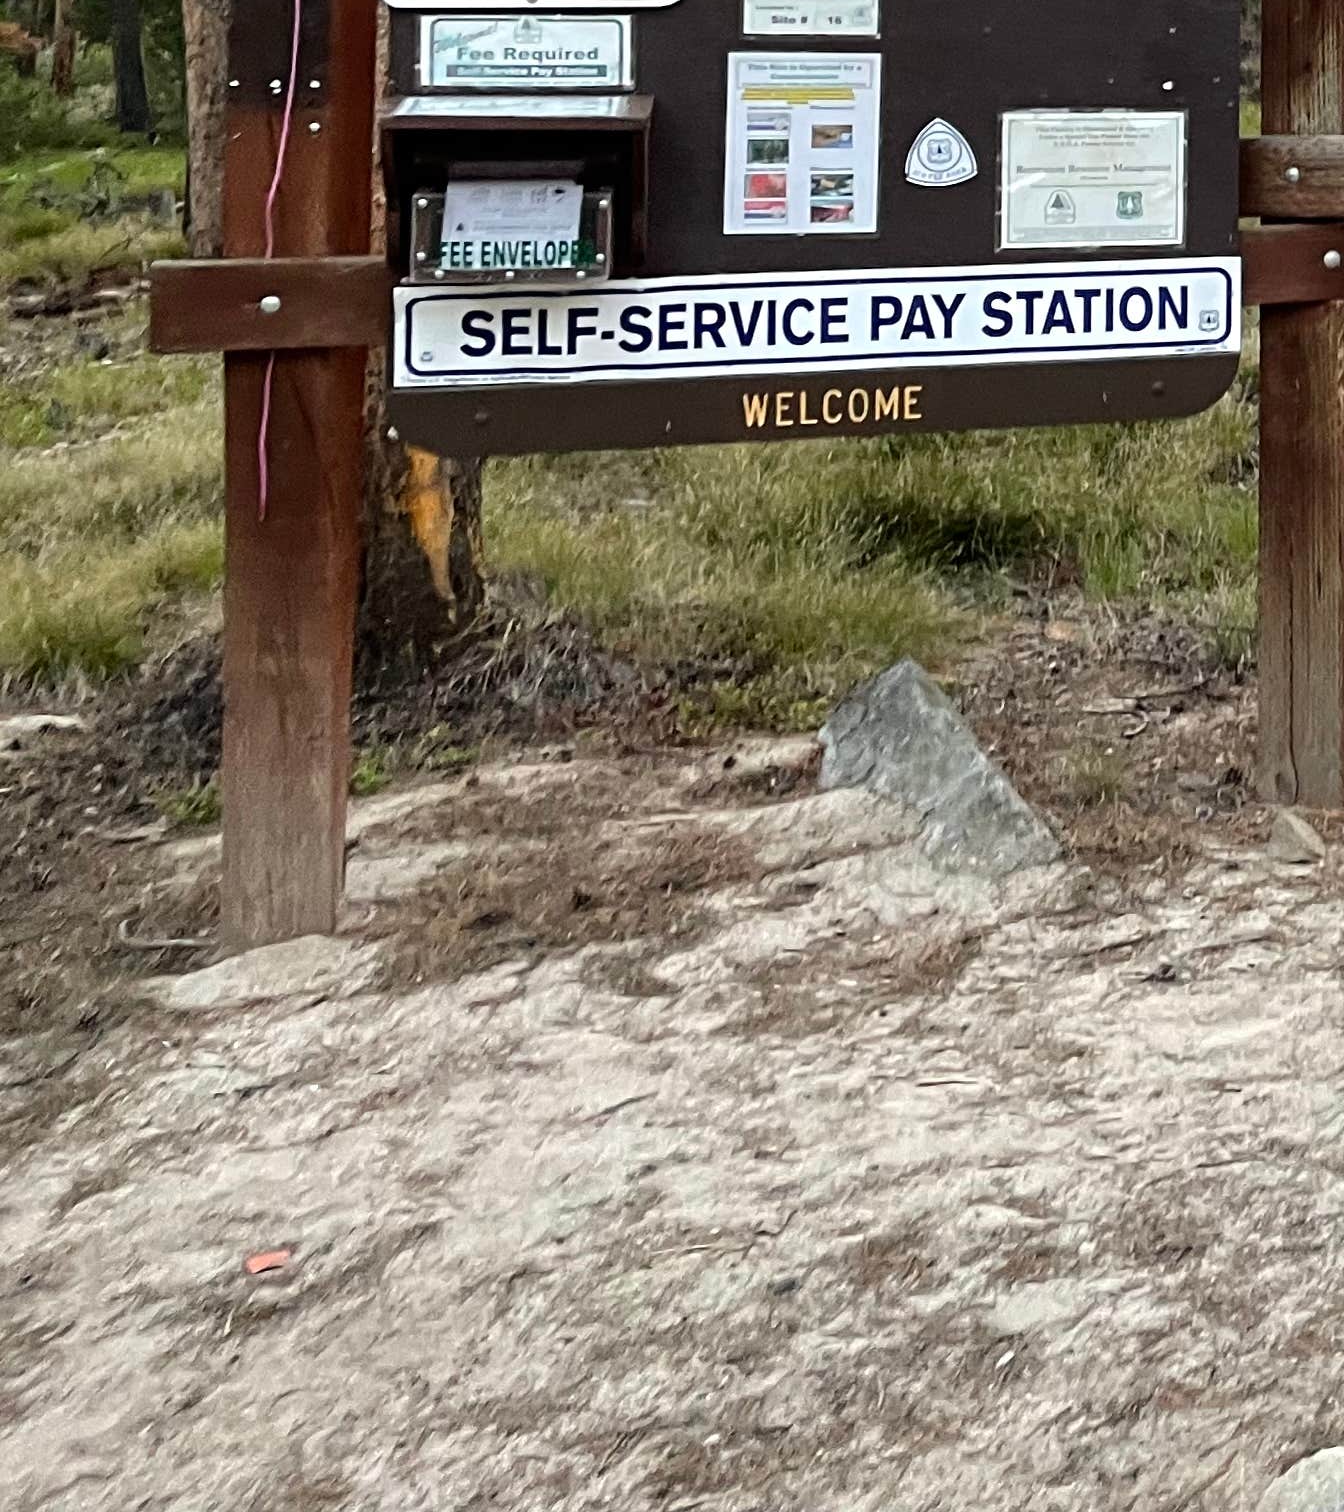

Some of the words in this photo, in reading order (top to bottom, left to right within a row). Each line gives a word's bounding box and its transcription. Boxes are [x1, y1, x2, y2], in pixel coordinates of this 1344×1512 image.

[457, 48, 494, 60] Fee
[503, 48, 599, 63] Required
[441, 240, 473, 268] FEE
[460, 298, 849, 357] SELF-SERVICE
[871, 293, 966, 341] PAY
[982, 286, 1188, 338] STATION
[743, 386, 923, 428] WELCOME
